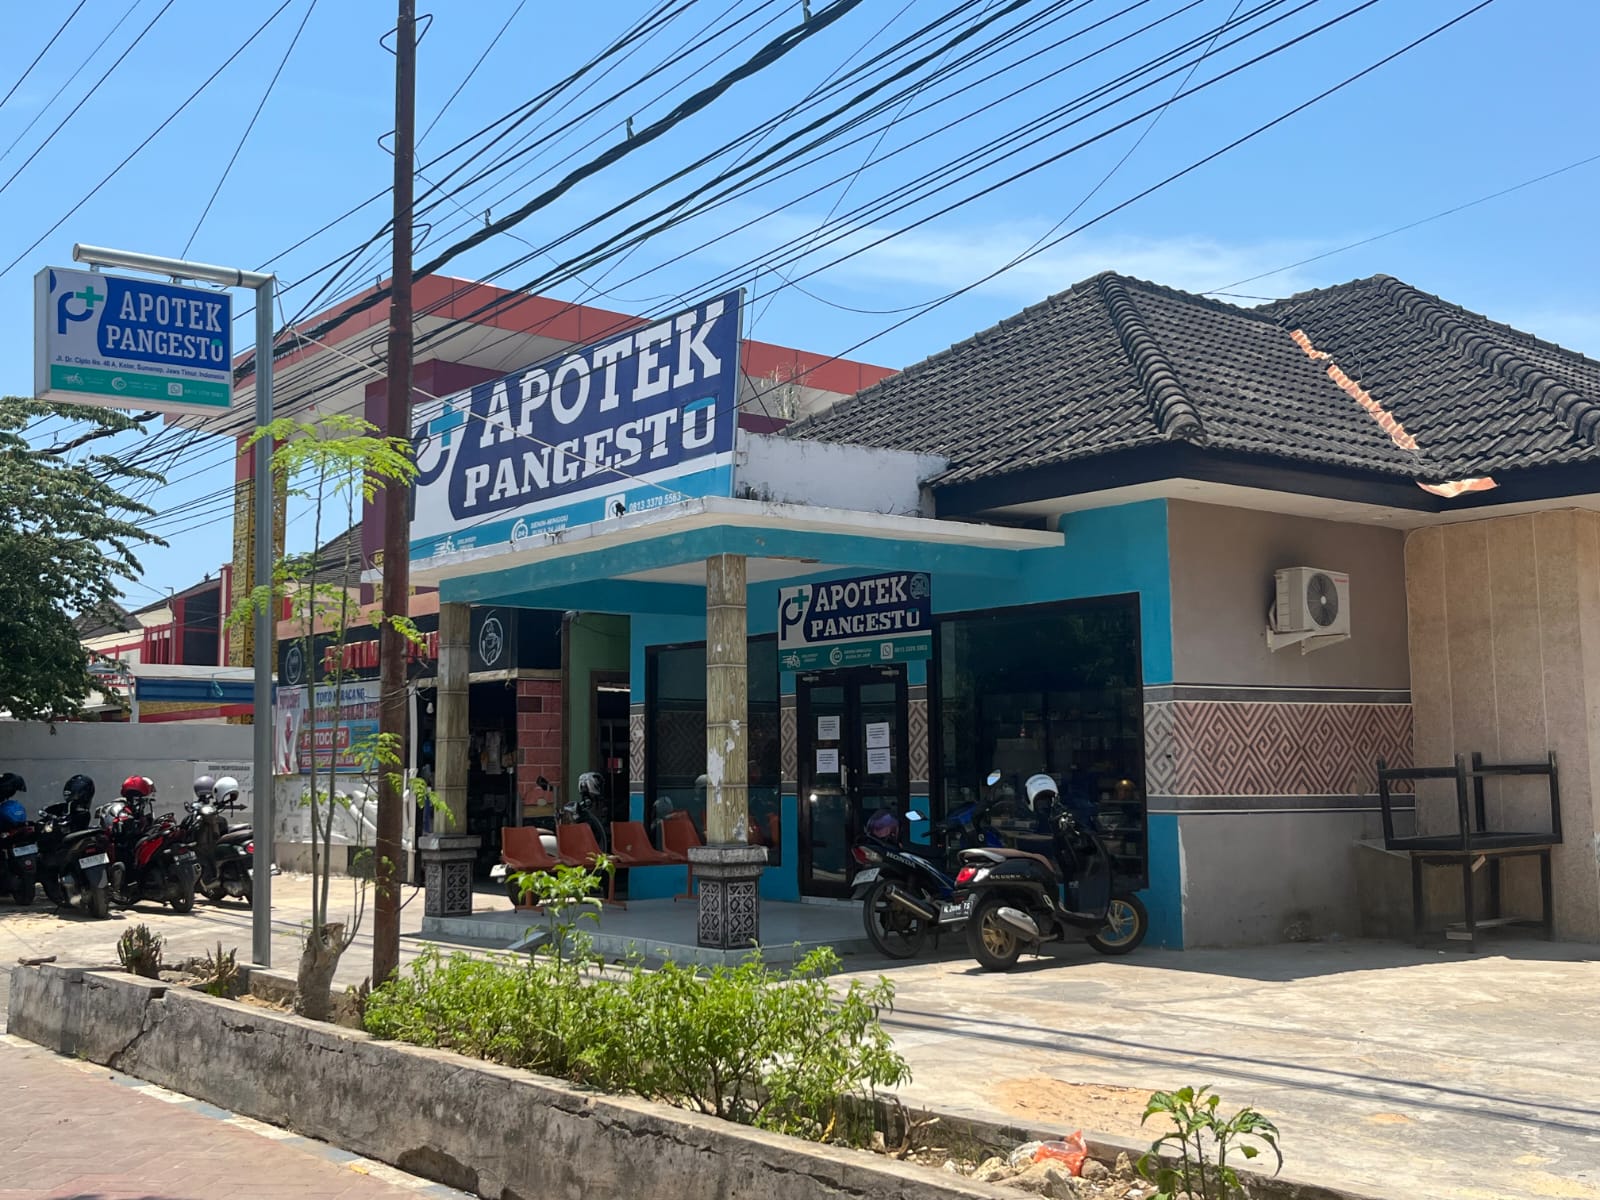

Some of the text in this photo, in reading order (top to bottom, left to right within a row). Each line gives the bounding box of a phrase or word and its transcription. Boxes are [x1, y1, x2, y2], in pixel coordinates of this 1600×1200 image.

[119, 290, 223, 333] APOTEK
[106, 324, 224, 362] PANGESTU
[479, 298, 725, 449] APOTEK
[463, 396, 717, 508] PANGESTU
[815, 575, 907, 612] APOTEK
[810, 607, 920, 638] PANGESTU
[886, 851, 916, 869] HONDA
